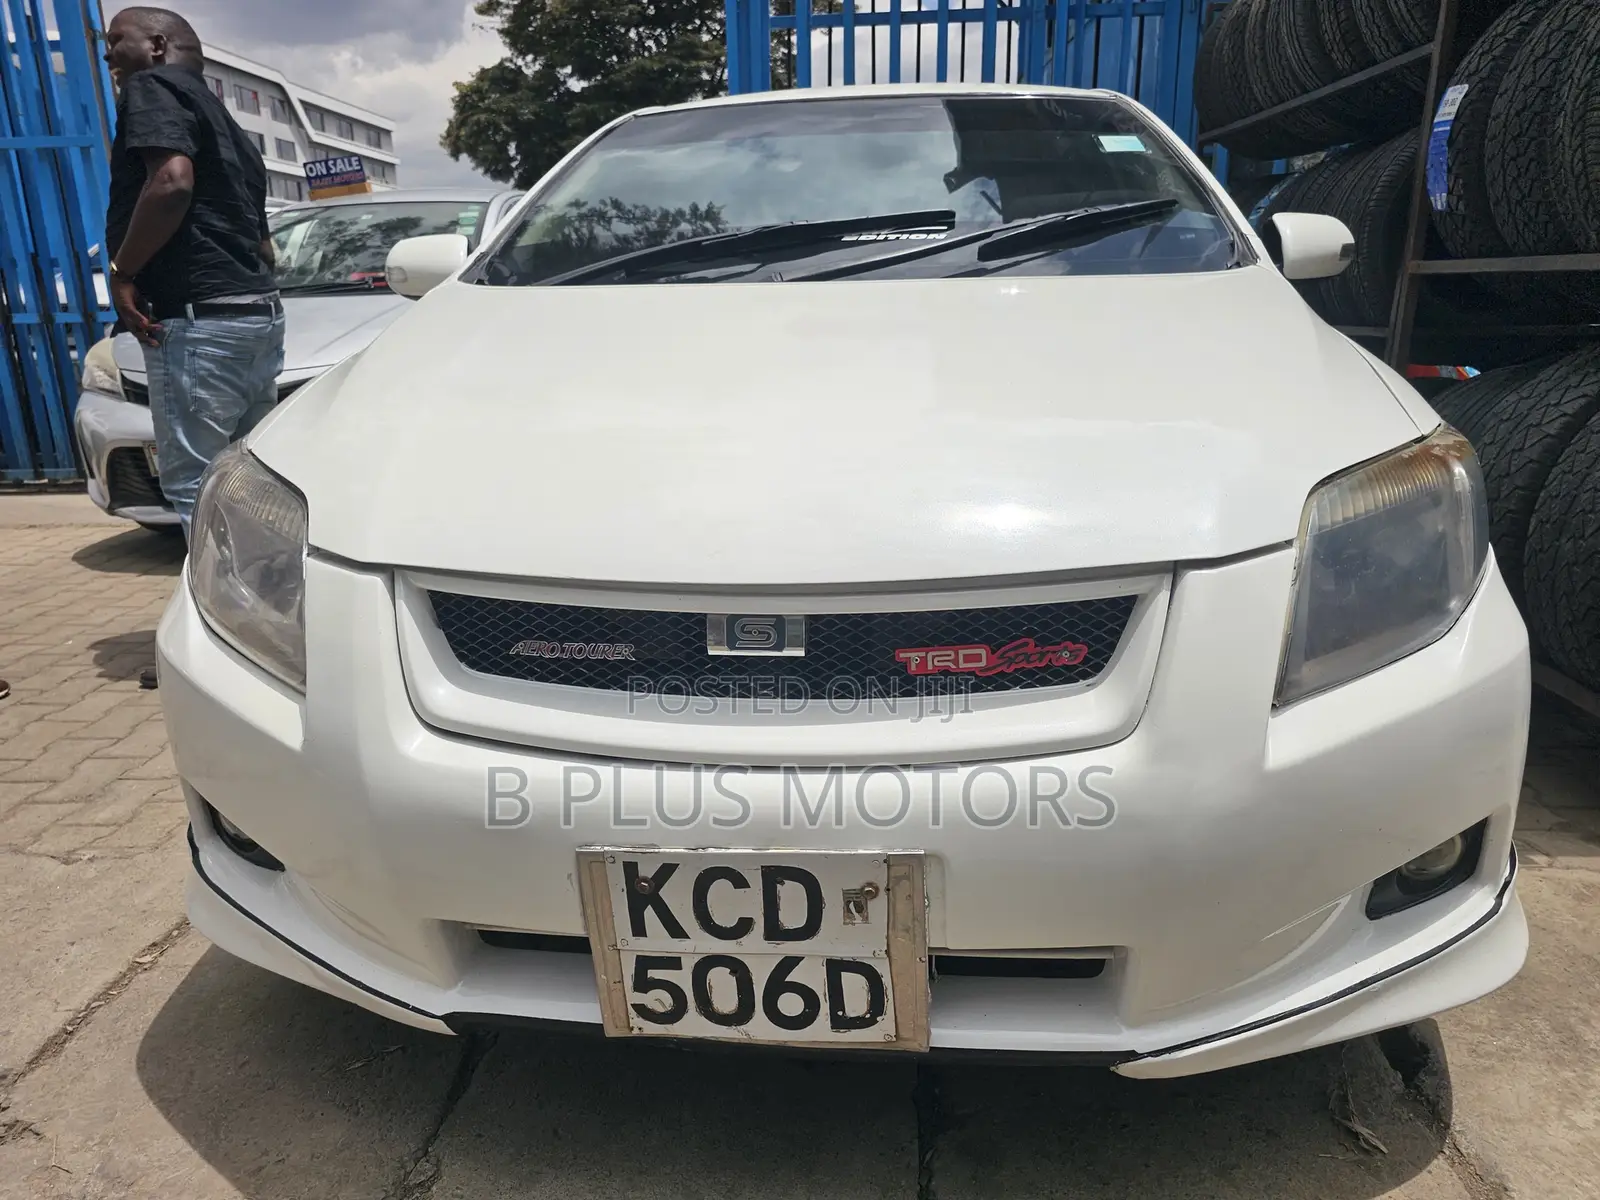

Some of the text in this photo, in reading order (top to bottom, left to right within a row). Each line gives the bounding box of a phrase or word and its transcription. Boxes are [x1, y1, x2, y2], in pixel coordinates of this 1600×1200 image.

[306, 156, 361, 177] ON SALE
[509, 640, 636, 661] AERO TOURER
[899, 648, 988, 671] TRD
[622, 860, 824, 942] KCD
[630, 954, 887, 1032] 506D
